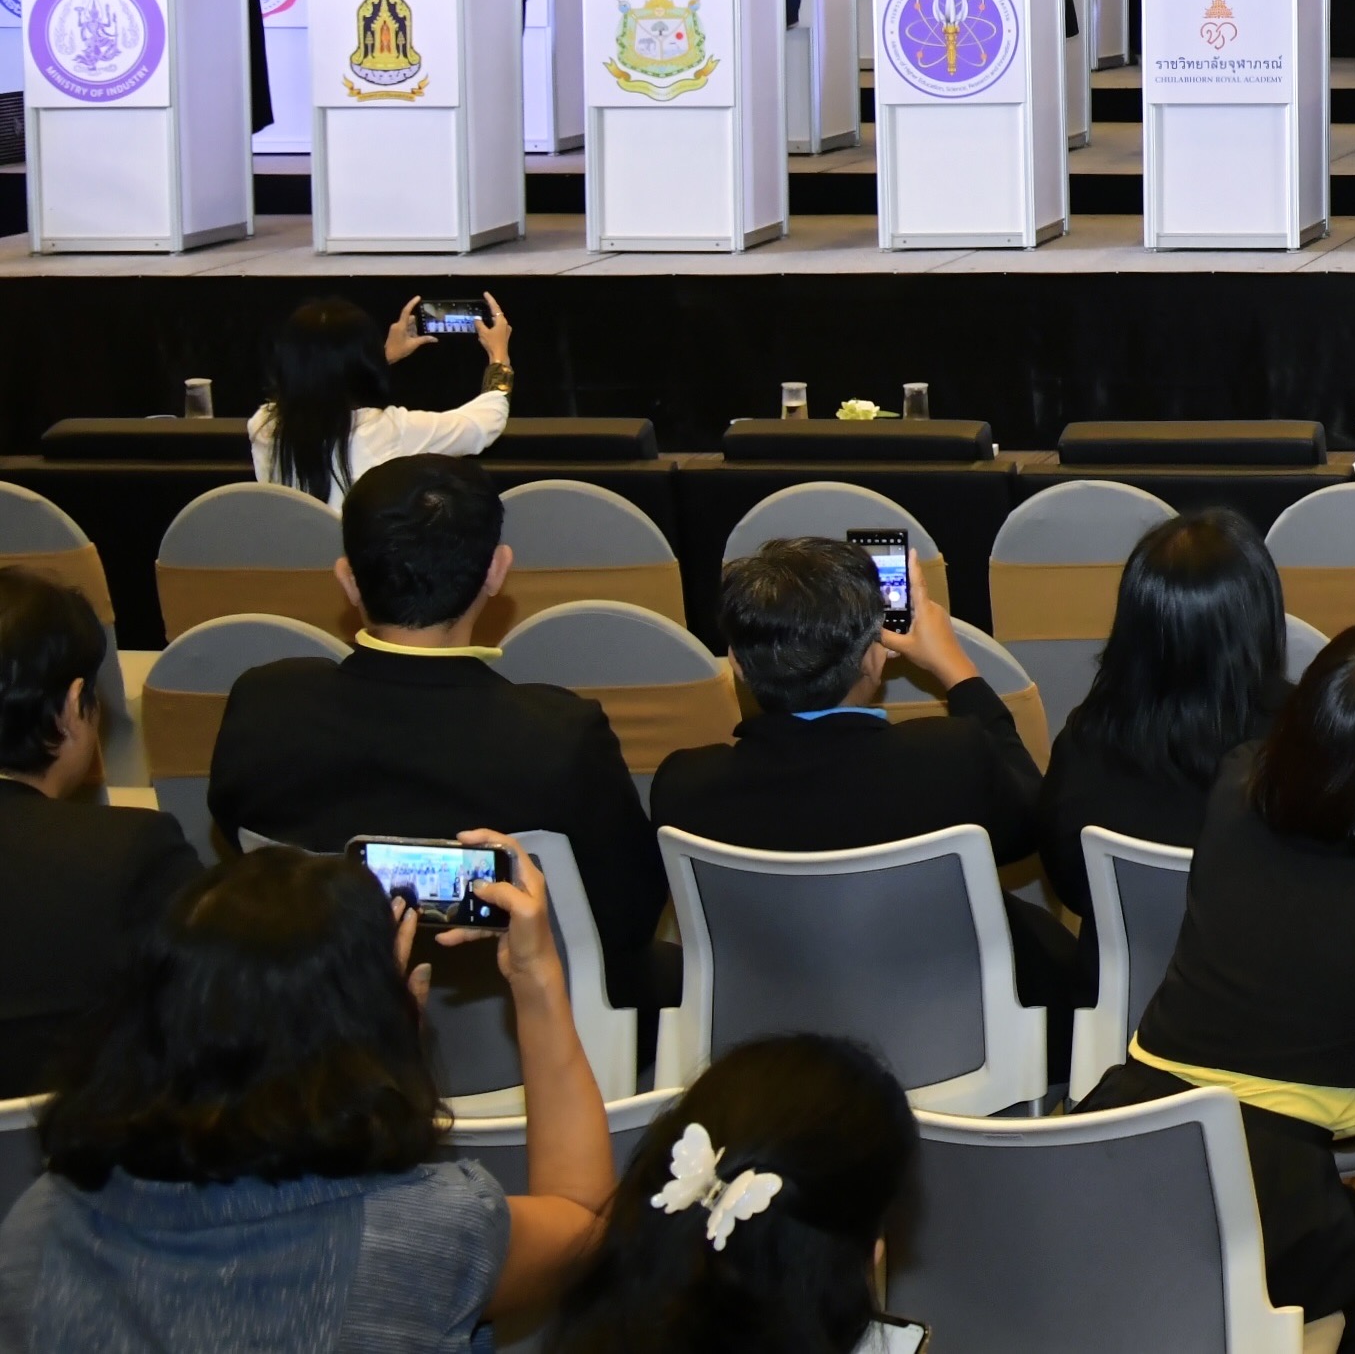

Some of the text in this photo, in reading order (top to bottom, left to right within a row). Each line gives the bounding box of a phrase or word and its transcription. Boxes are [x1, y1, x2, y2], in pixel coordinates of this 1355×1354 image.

[1155, 54, 1283, 73] ราชวิทยาลัยจุฬาภรณ์
[45, 65, 150, 97] MINISTRY OF INDUSTRY
